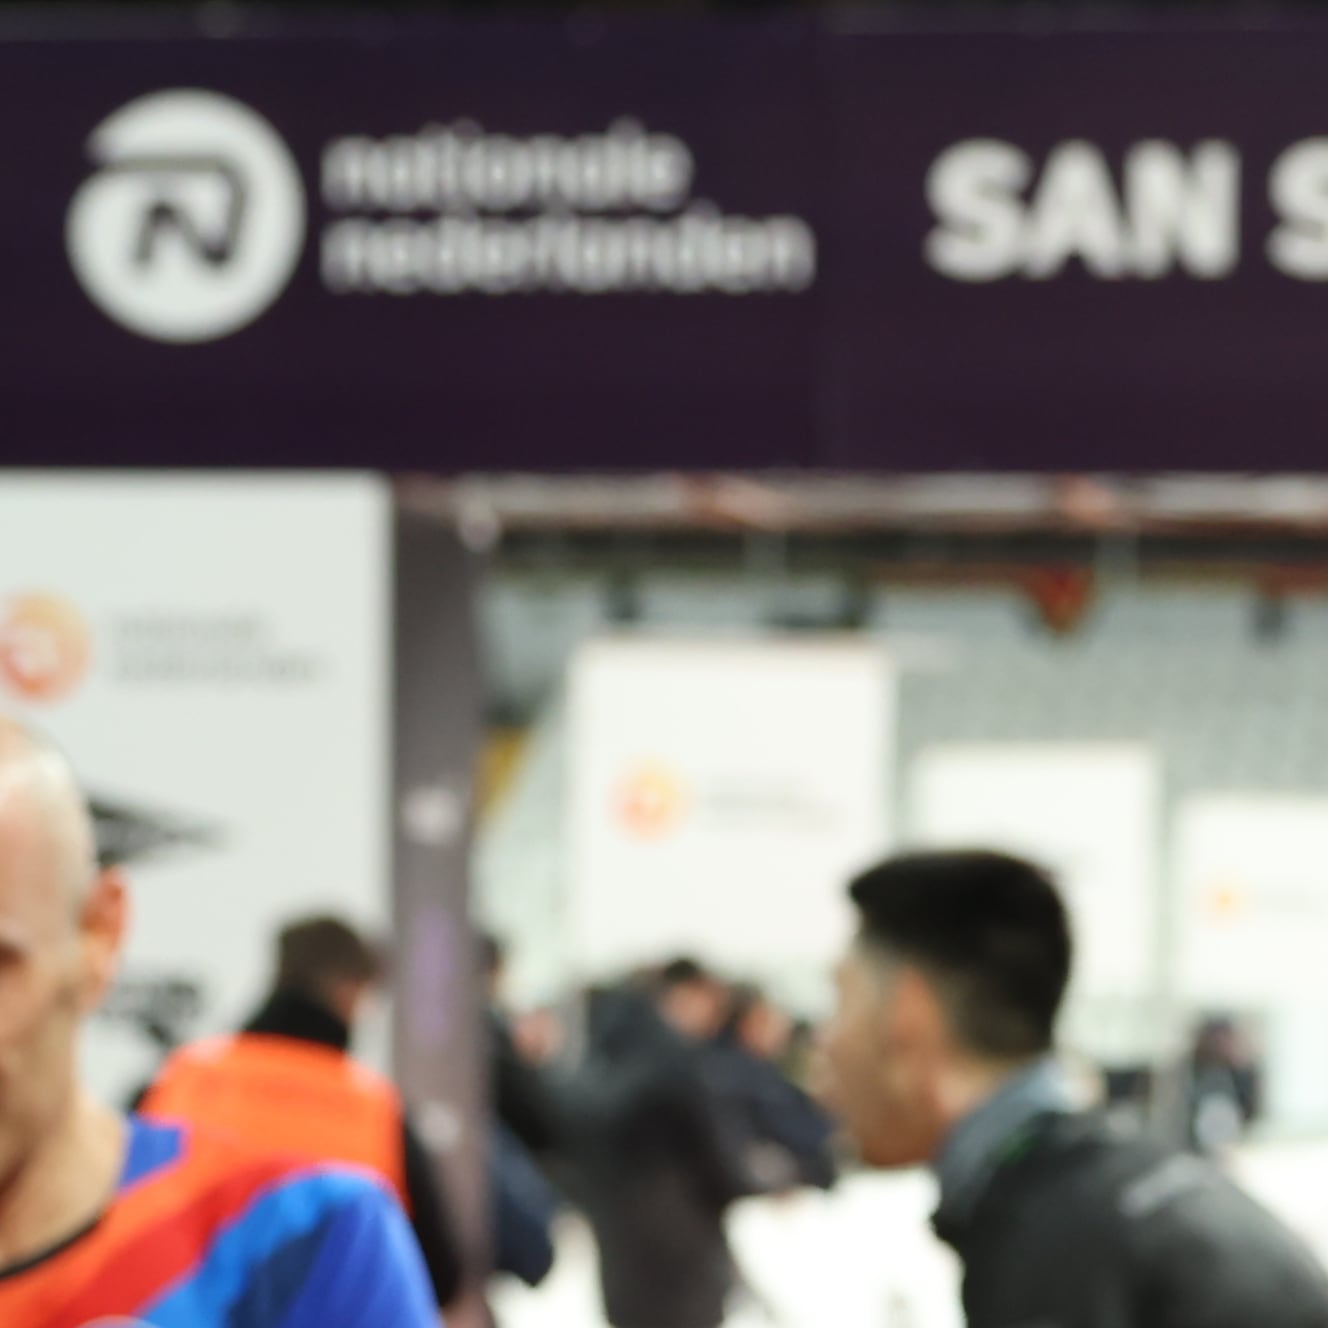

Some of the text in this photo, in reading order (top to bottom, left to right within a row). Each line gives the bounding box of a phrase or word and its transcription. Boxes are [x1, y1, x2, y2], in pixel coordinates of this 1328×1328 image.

[323, 120, 690, 208] nationale
[323, 203, 813, 290] nederlanden
[929, 140, 1240, 280] SAN
